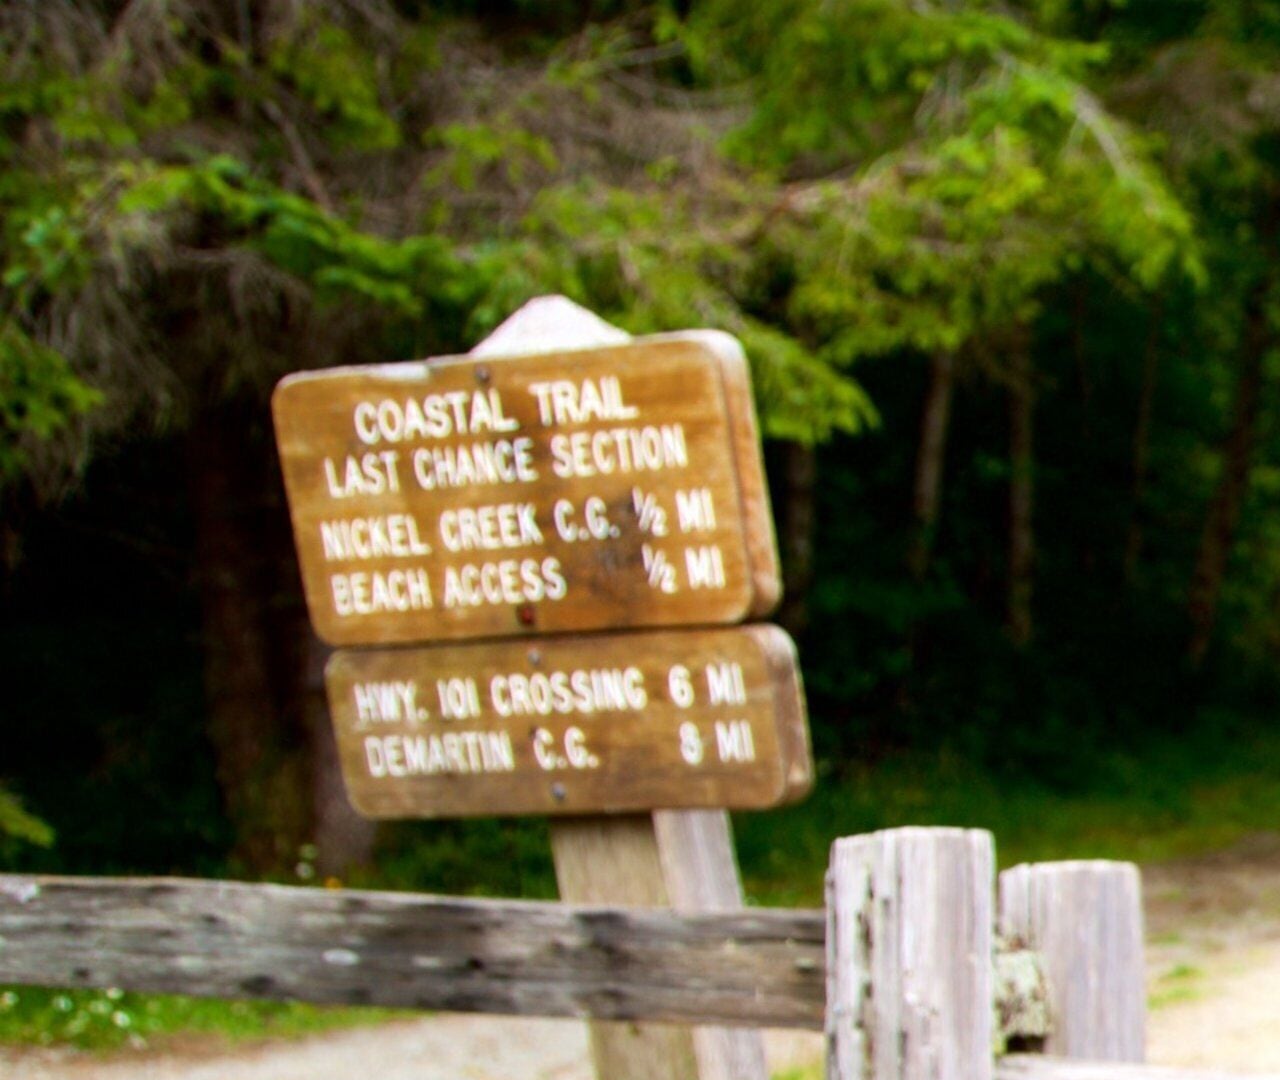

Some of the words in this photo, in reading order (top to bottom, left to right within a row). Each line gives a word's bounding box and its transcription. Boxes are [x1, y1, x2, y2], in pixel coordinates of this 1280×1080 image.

[354, 388, 518, 444] COASTAL
[529, 375, 639, 426] TRAIL
[325, 450, 399, 499] LAST
[414, 438, 538, 491] CHANCE
[551, 424, 688, 478] SECTION
[319, 514, 431, 562] NICKEL
[439, 503, 544, 553] CREEK
[554, 496, 620, 543] C.G.
[675, 488, 717, 533] MI
[331, 567, 432, 617] BEACH
[444, 556, 567, 608] ACCESS
[685, 546, 726, 590] MI
[353, 681, 429, 724] HWY.
[438, 677, 481, 719] 101
[490, 666, 647, 717] CROSSING
[668, 664, 694, 709] 6
[706, 661, 747, 707] MI
[364, 729, 515, 778] DEMARTIN
[533, 726, 599, 770] C.G.
[679, 720, 704, 766] 8
[715, 721, 755, 763] MI
